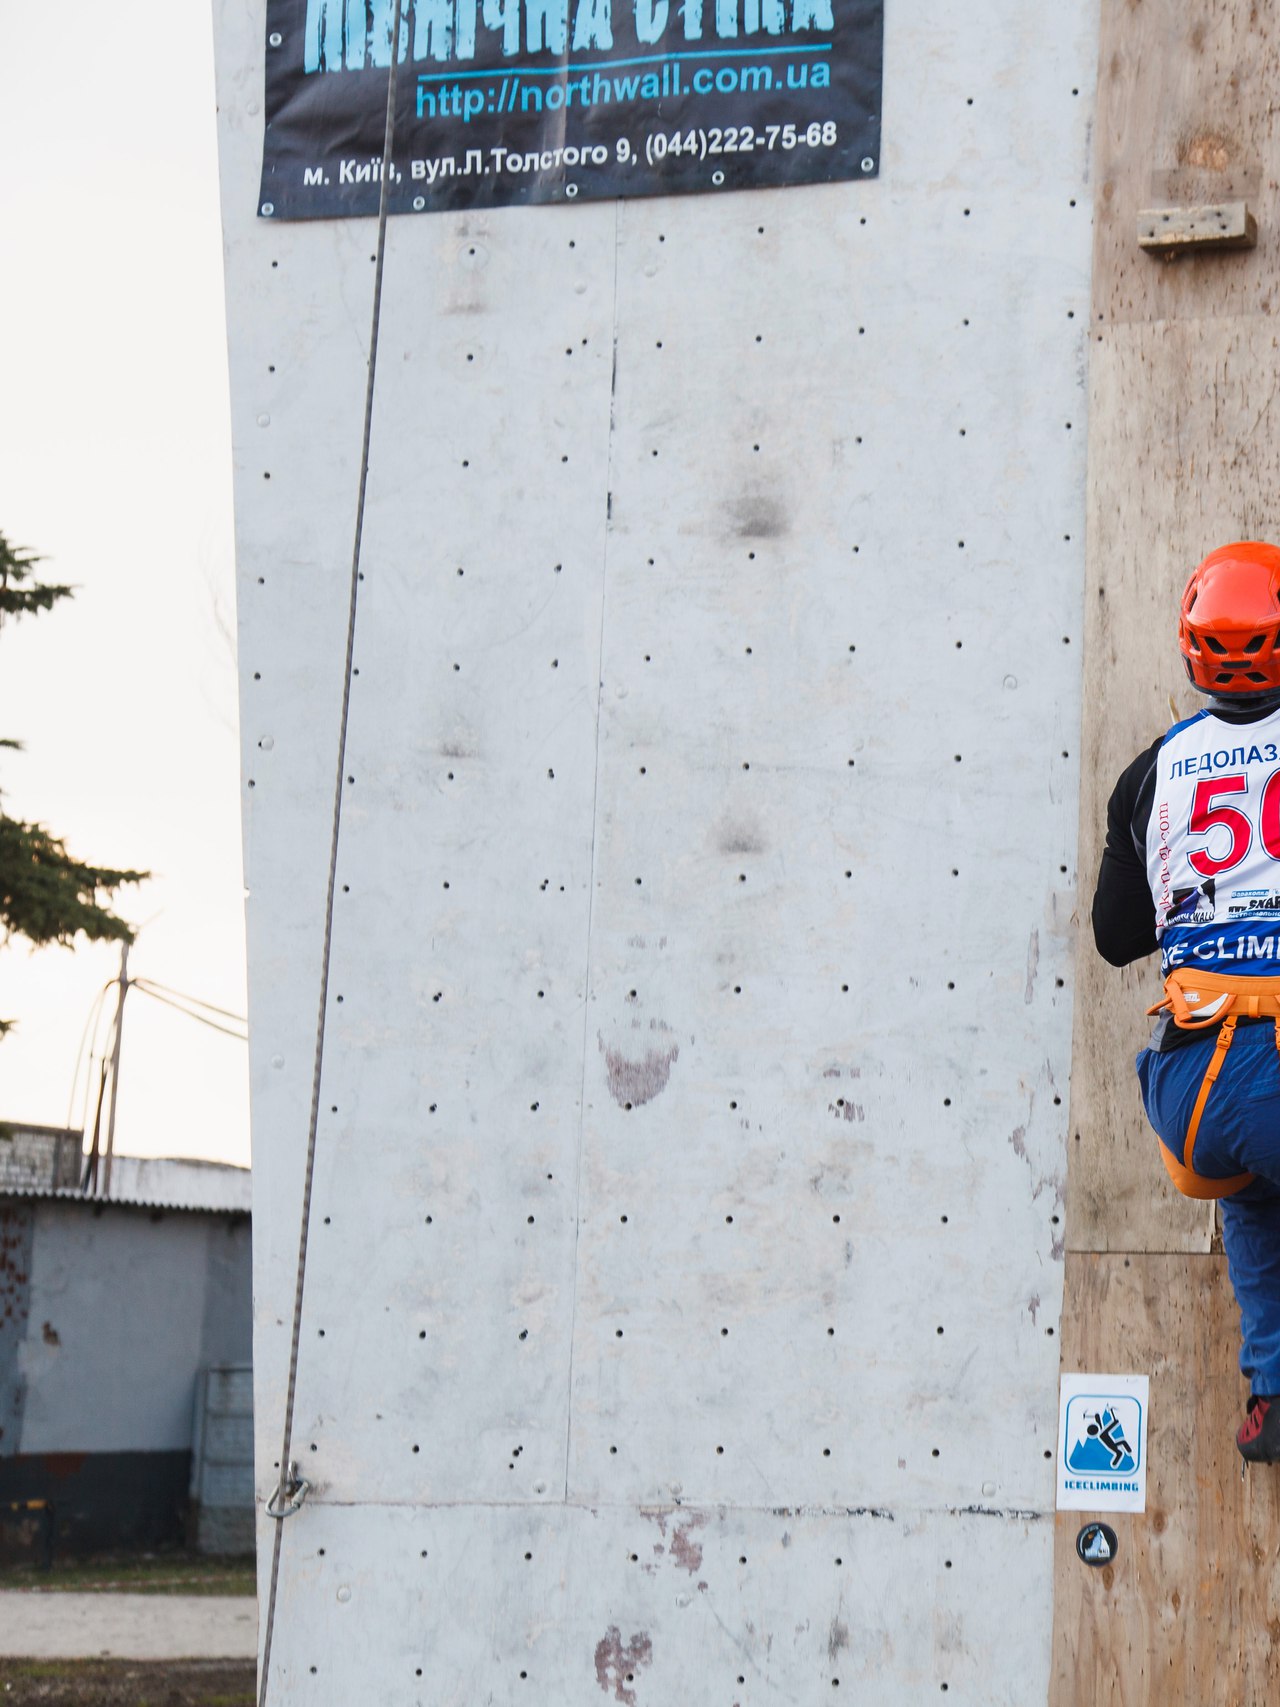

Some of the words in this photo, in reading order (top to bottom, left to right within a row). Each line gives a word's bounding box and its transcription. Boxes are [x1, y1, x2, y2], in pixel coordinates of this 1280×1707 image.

[416, 61, 831, 122] http://northwall.com.ua
[303, 167, 330, 187] м.
[616, 137, 639, 166] 9,
[645, 121, 838, 161] (044)222-75-68
[1065, 1480, 1139, 1491] ICECLIMBING
